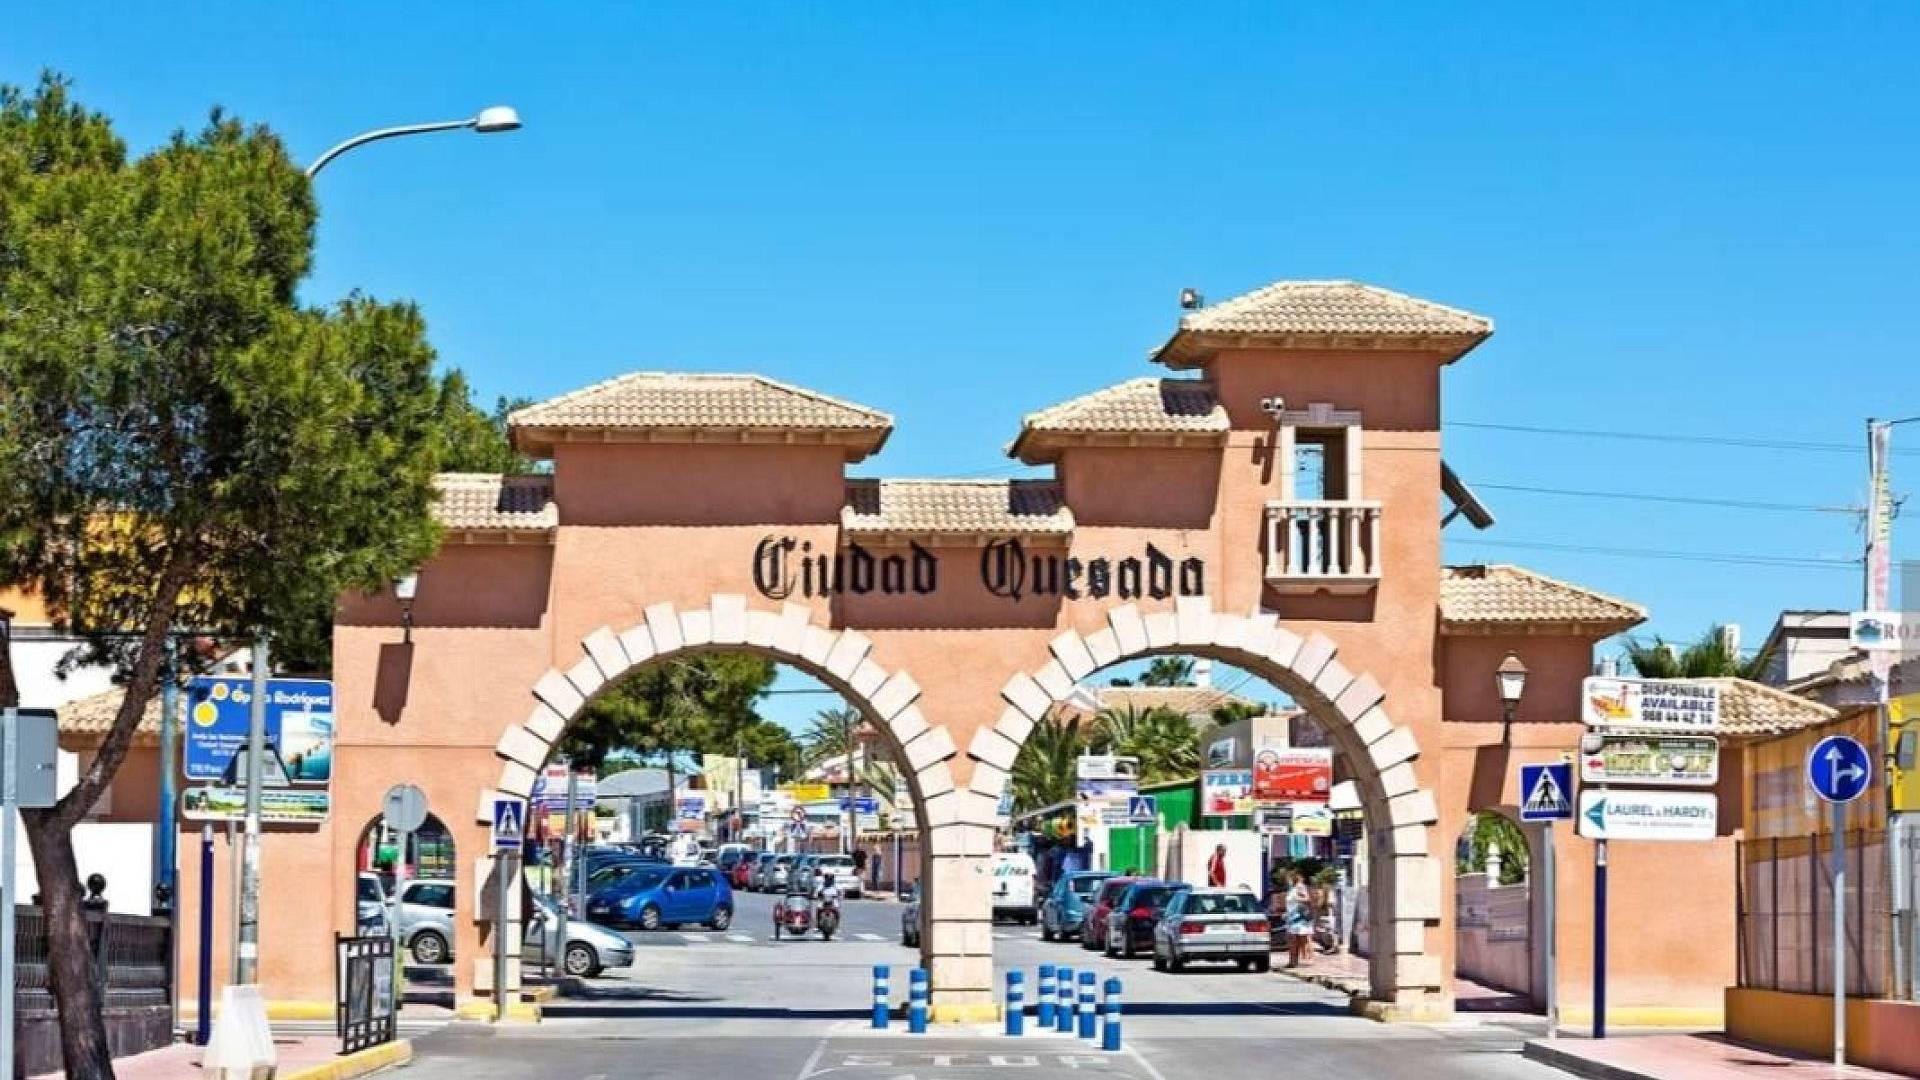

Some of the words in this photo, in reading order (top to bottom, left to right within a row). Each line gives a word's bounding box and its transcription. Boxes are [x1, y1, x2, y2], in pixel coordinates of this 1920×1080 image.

[753, 534, 938, 600] Ciudad
[980, 536, 1206, 601] Quesada
[1641, 683, 1715, 698] DISPONIBLE
[1641, 697, 1715, 712] AVAILABLE
[1607, 804, 1654, 816] LAUREL
